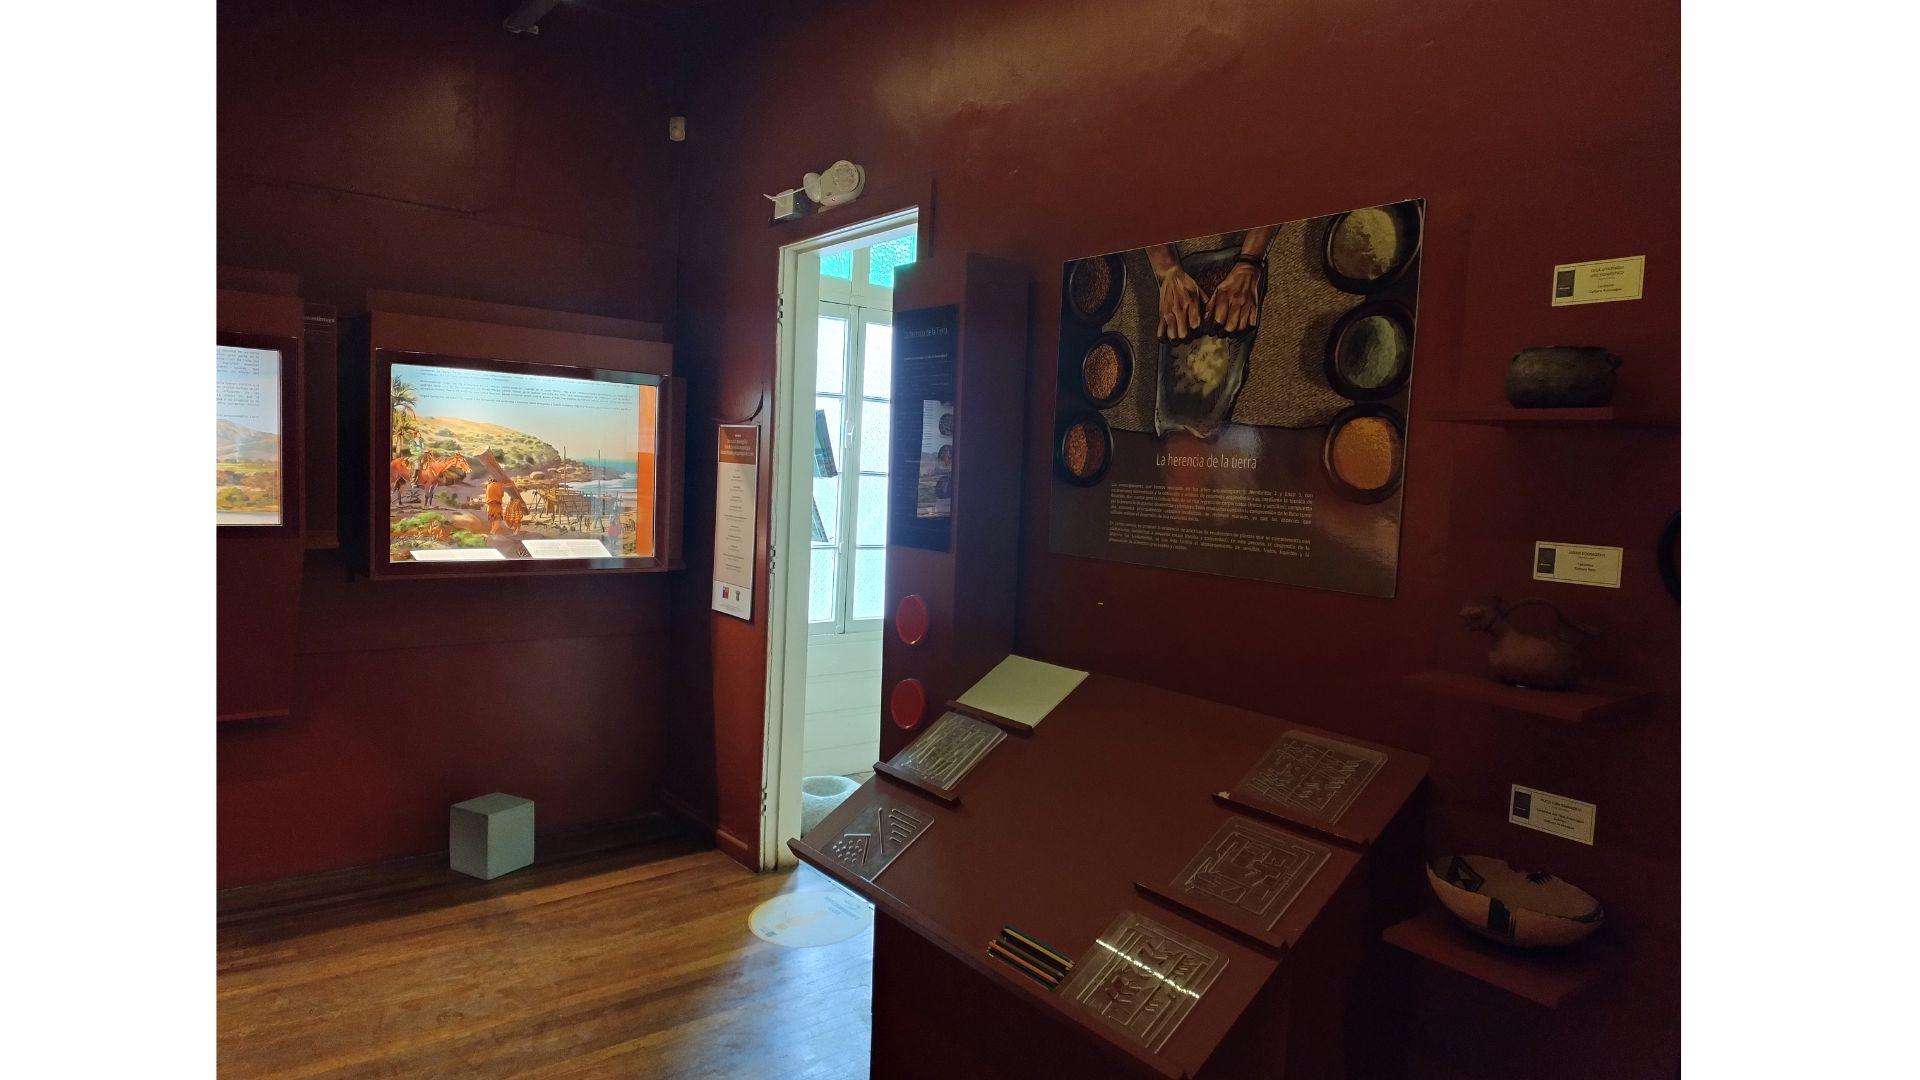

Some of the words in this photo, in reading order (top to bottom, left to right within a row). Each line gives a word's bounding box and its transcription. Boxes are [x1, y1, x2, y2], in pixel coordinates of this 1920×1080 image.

[1156, 453, 1166, 466] La
[1168, 453, 1205, 468] herencia
[1207, 453, 1219, 468] de
[1221, 453, 1229, 468] la
[1231, 455, 1257, 469] tierra
